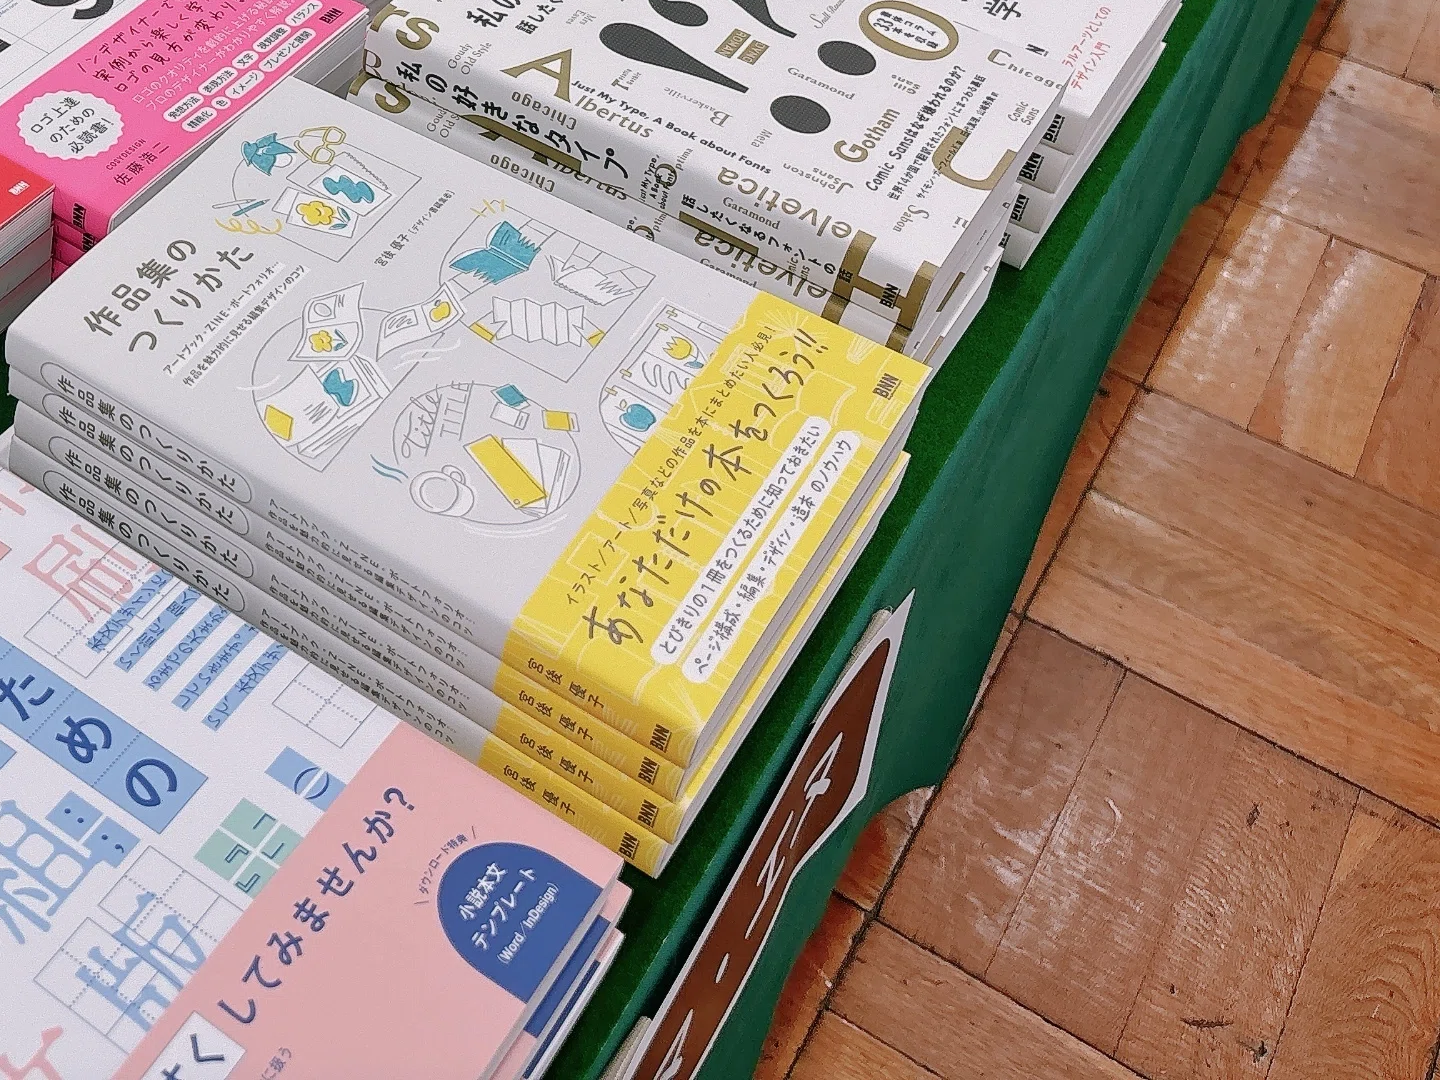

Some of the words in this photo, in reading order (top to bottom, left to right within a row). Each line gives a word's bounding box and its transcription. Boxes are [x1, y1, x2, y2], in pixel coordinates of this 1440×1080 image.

[145, 0, 296, 111] プロのデザイナーがわかりやすく解説。
[167, 95, 202, 120] 発想方法
[201, 69, 236, 95] 表現方法
[236, 52, 255, 68] 文字
[256, 26, 290, 51] 視覚調整
[290, 1, 321, 25] バランス
[230, 70, 261, 97] イメージ
[263, 30, 314, 70] プレゼンと展開
[786, 67, 856, 101] Garamond
[1070, 42, 1112, 92] デザイン入門
[30, 94, 82, 136] ロゴ上達
[49, 105, 98, 146] のための
[394, 60, 630, 180] 私の好きなタイプ
[511, 90, 577, 131] Chicago
[572, 79, 596, 95] Just
[596, 90, 618, 106] My
[619, 101, 650, 122] Type,
[652, 116, 664, 126] A
[665, 120, 698, 141] Book
[699, 136, 738, 160] about
[738, 154, 772, 175] Fonts
[833, 108, 901, 163] Gotham
[113, 142, 171, 187] 佐藤浩二
[865, 163, 895, 192] Comic
[681, 194, 853, 284] 話したくなるフォントの話
[722, 197, 780, 231] Garamond
[83, 237, 197, 339] 作品集の
[128, 245, 254, 354] つくりかた
[182, 264, 305, 387] 作品を魅力的に見せる編集デザインのコツ
[56, 375, 238, 494] 作品集のつくりかた
[57, 405, 235, 524] 作品集のつくりかた
[64, 448, 240, 568] 作品集のつくりかた
[659, 423, 821, 656] とびきりの1冊をつくるために知っておきたい
[694, 494, 816, 675] ページ構成・編集・デザイン・造本
[811, 438, 853, 493] のノウハウ
[418, 832, 469, 894] ダウンロード特典
[458, 861, 508, 921] 小説本文
[471, 866, 538, 951] テンプレート
